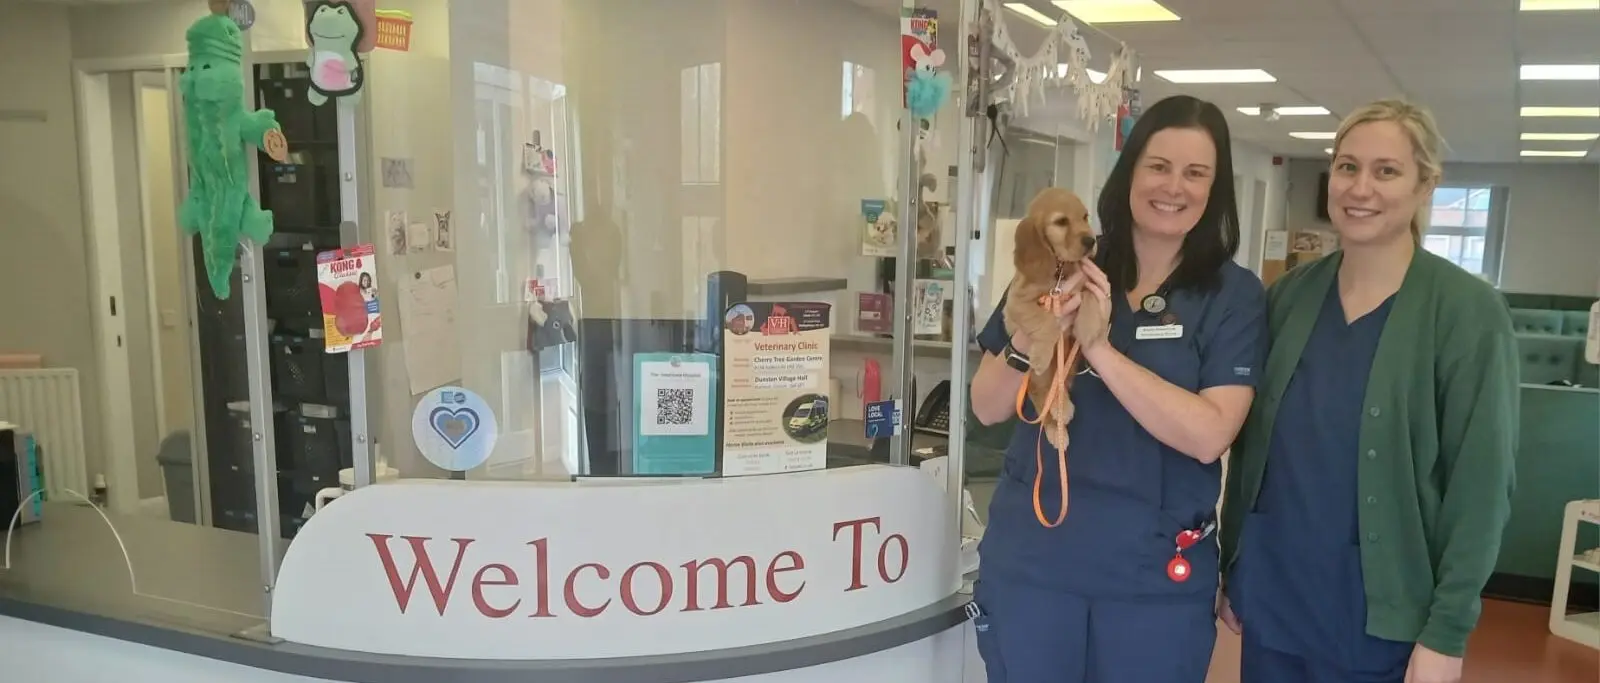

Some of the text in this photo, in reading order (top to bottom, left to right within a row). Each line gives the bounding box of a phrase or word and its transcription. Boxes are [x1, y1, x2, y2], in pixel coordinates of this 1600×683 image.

[330, 259, 355, 273] KONG
[754, 341, 819, 353] Veterinary Clinic
[754, 356, 773, 364] Cherry
[778, 374, 796, 383] Village
[365, 516, 909, 619] Welcome To
